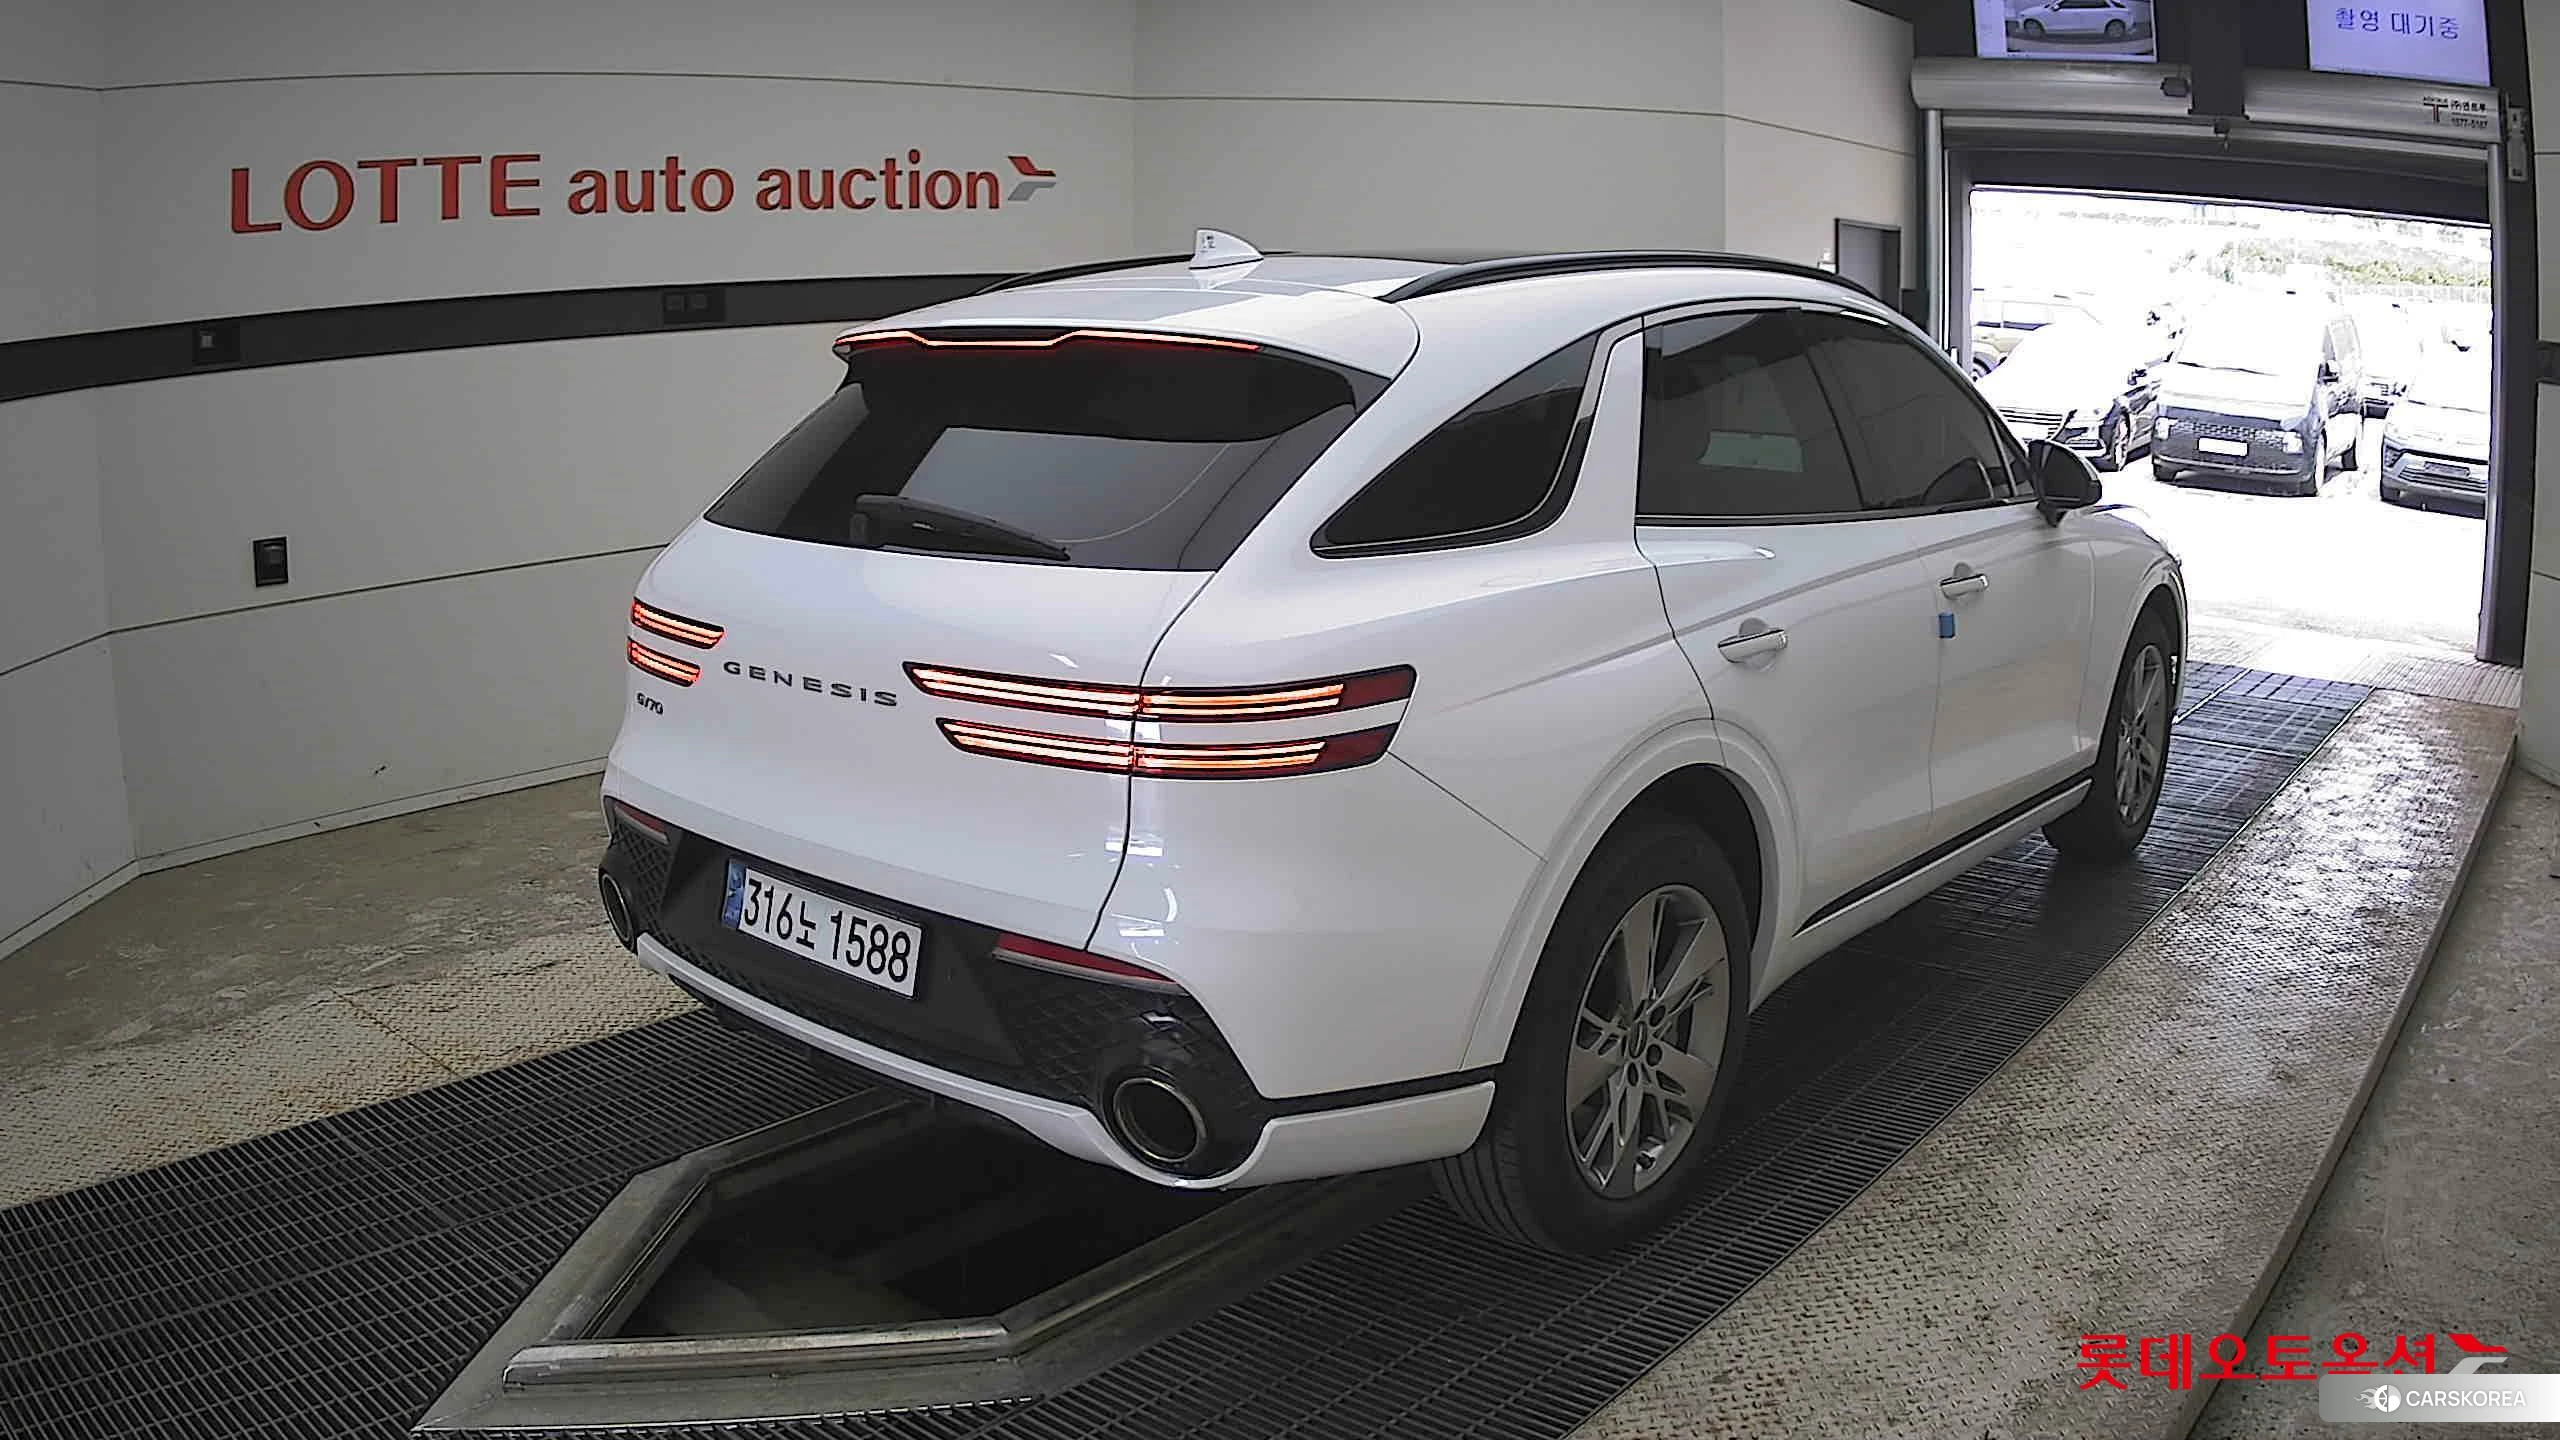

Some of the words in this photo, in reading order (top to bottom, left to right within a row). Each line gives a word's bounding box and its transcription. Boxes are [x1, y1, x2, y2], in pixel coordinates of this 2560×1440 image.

[2335, 7, 2379, 32] 촬영
[2391, 12, 2460, 40] 대기중
[230, 153, 542, 235] LOTTE
[568, 155, 735, 215] auto
[756, 149, 1001, 212] auction
[723, 660, 898, 707] GENESIS
[744, 878, 817, 950] 316노
[830, 910, 911, 983] 1588
